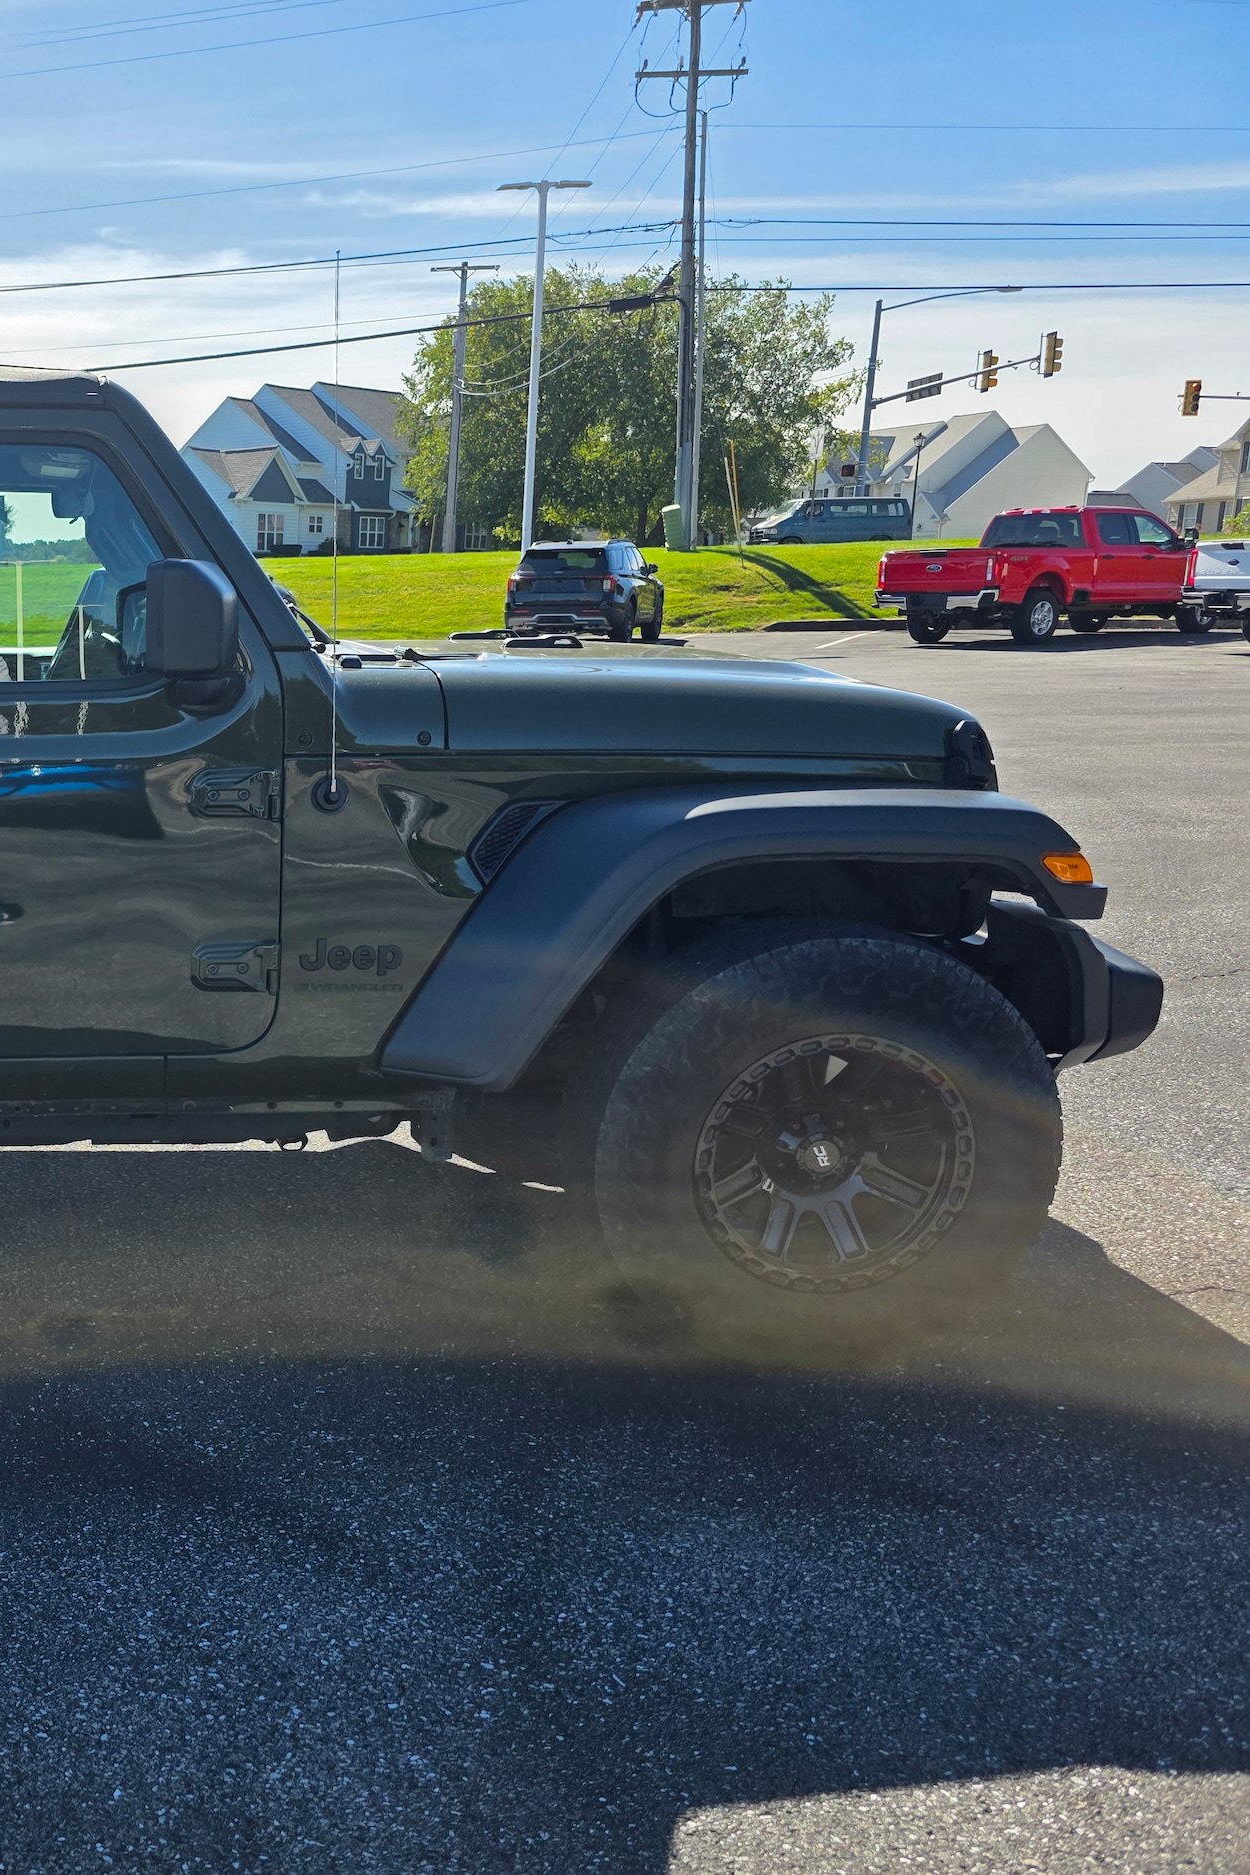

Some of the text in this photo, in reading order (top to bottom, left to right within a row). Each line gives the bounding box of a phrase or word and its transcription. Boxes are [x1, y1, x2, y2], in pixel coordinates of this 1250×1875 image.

[299, 937, 403, 976] Jeep
[309, 982, 404, 992] WRANGLER
[812, 1145, 830, 1167] RC
